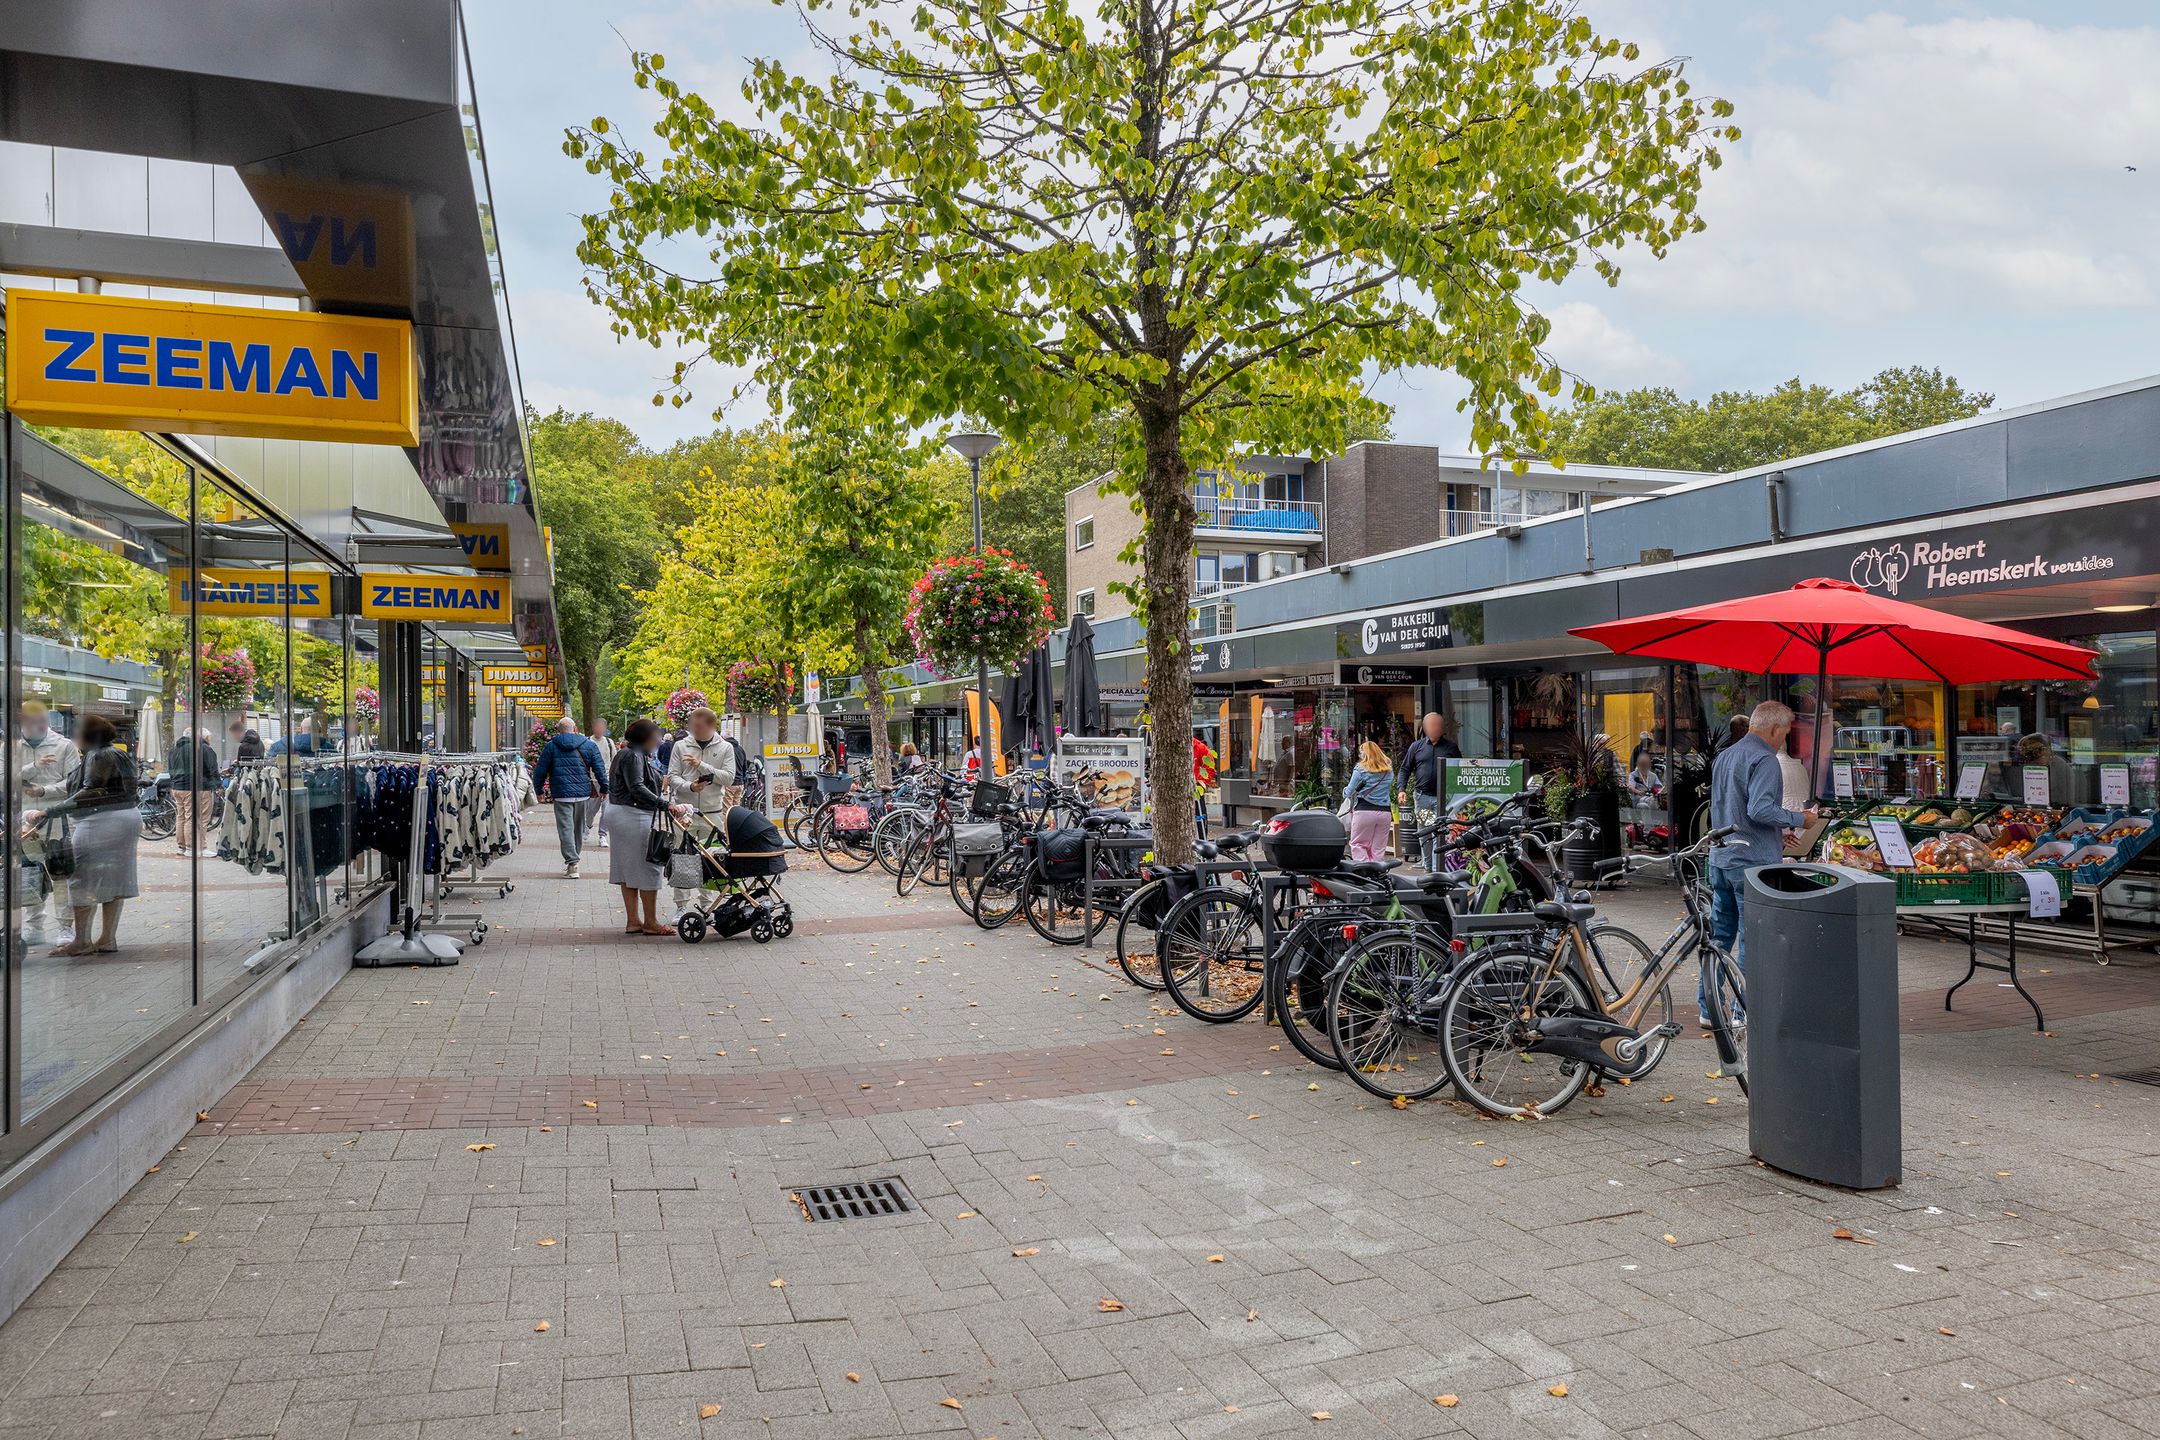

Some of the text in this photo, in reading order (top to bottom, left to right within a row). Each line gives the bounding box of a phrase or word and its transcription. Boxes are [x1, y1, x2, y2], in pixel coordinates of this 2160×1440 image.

[44, 328, 378, 401] ZEEMAN
[1913, 540, 1986, 566] Robert
[1927, 555, 2114, 589] Heemskerk versidee
[373, 586, 500, 609] ZEEMAN
[1391, 612, 1435, 628] BAKKERIJ
[1380, 625, 1449, 643] VAN DER GRIJN
[487, 670, 544, 681] JUMBO
[507, 685, 551, 693] JUMBO
[773, 745, 812, 754] JUMBO
[1074, 745, 1115, 756] Elke vrijdag
[1461, 767, 1507, 776] HUISGEMAAKTE
[1457, 776, 1511, 786] POKE BOWLS
